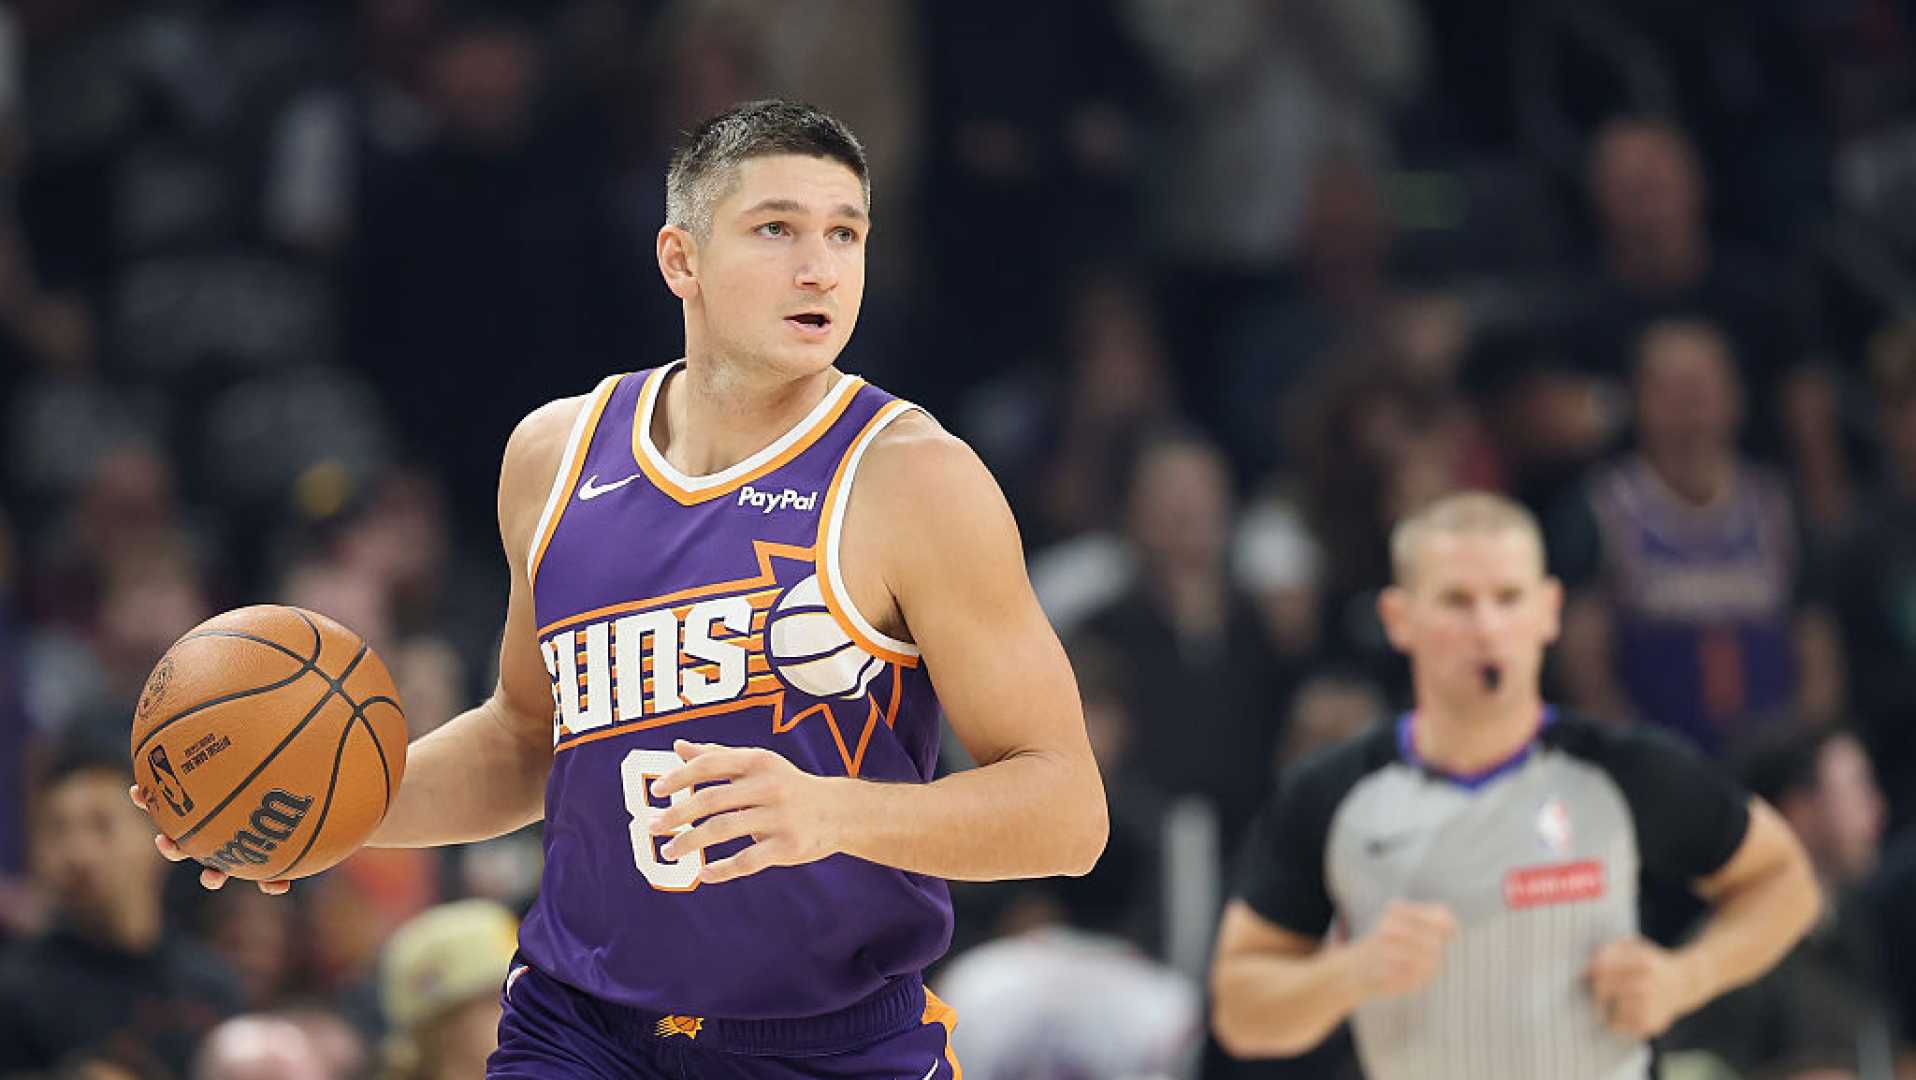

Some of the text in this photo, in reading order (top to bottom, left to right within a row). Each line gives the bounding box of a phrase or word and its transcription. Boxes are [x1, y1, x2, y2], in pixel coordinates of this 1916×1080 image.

[738, 486, 818, 514] PayPal
[203, 787, 314, 872] Wils
[620, 749, 705, 892] 8
